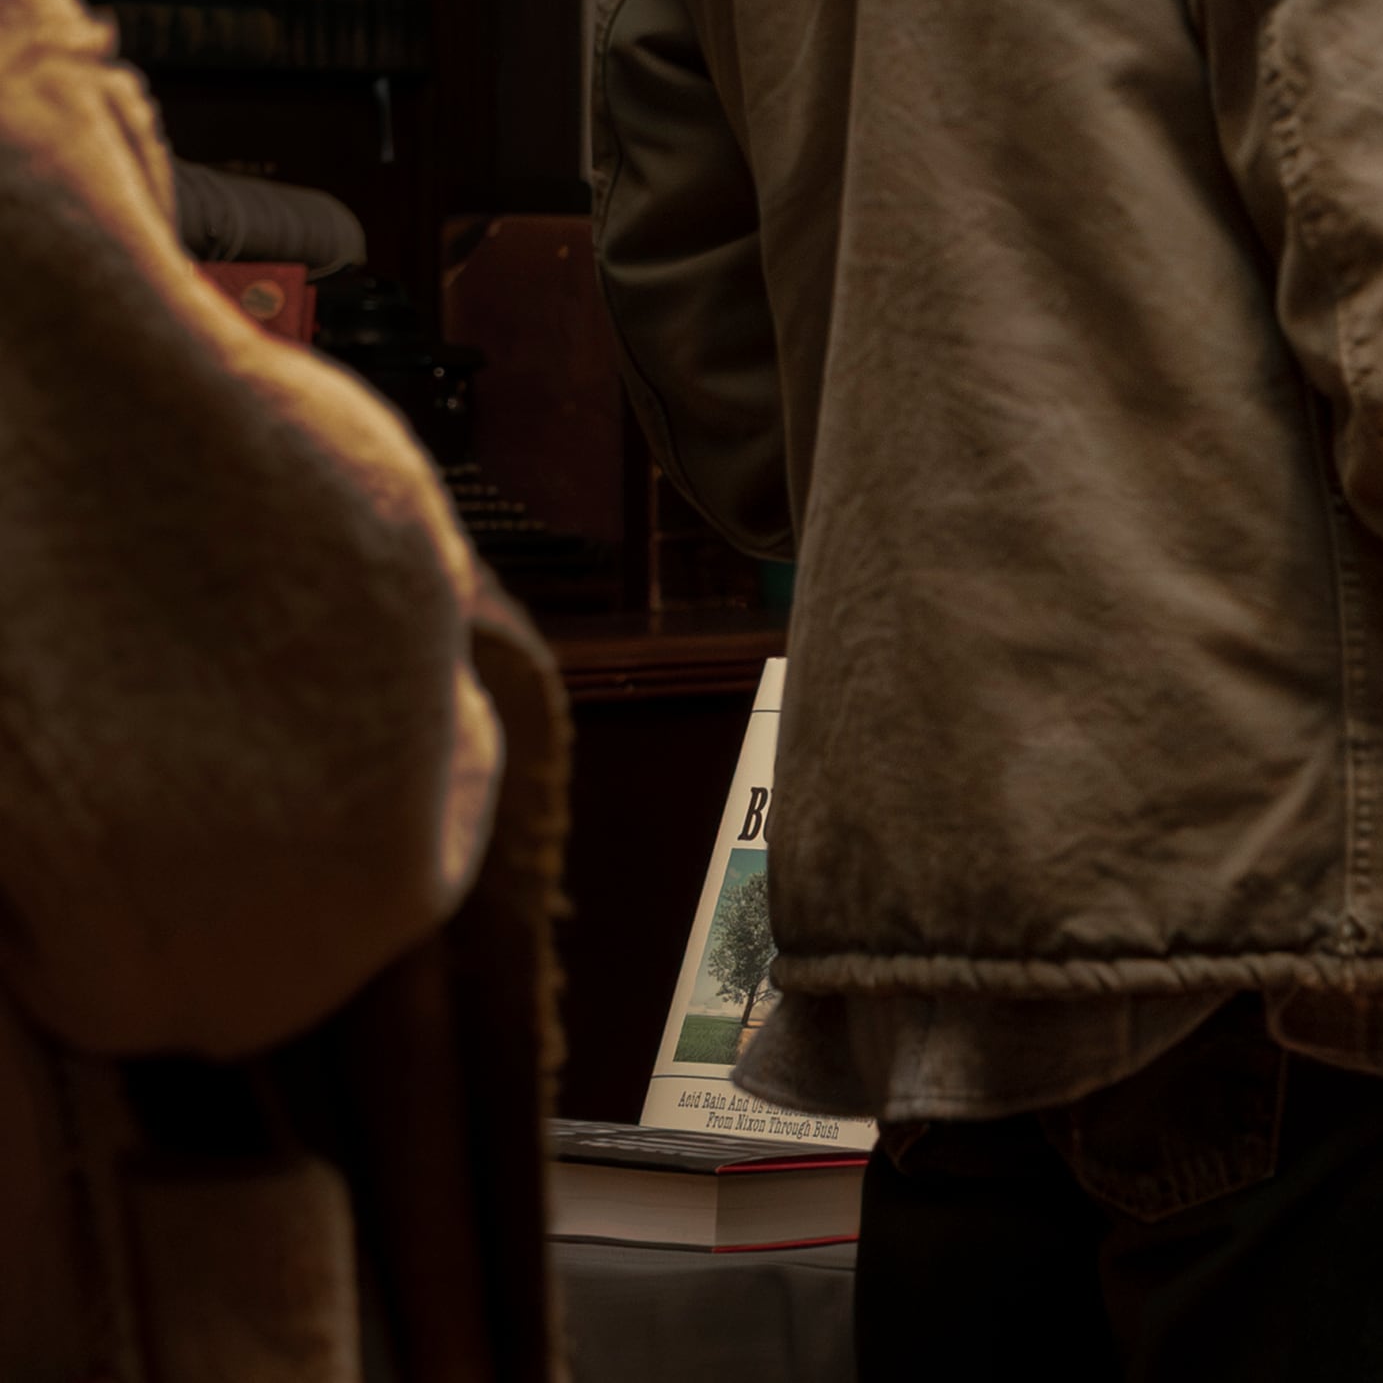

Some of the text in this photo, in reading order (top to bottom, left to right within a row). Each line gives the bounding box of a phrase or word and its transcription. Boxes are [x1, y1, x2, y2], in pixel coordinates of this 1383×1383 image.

[678, 1091, 702, 1108] Acid
[702, 1092, 727, 1110] Rain
[727, 1094, 748, 1112] And
[705, 1111, 734, 1129] From
[735, 1114, 765, 1134] Nixon
[768, 1116, 811, 1139] Through
[813, 1120, 841, 1141] Bush
